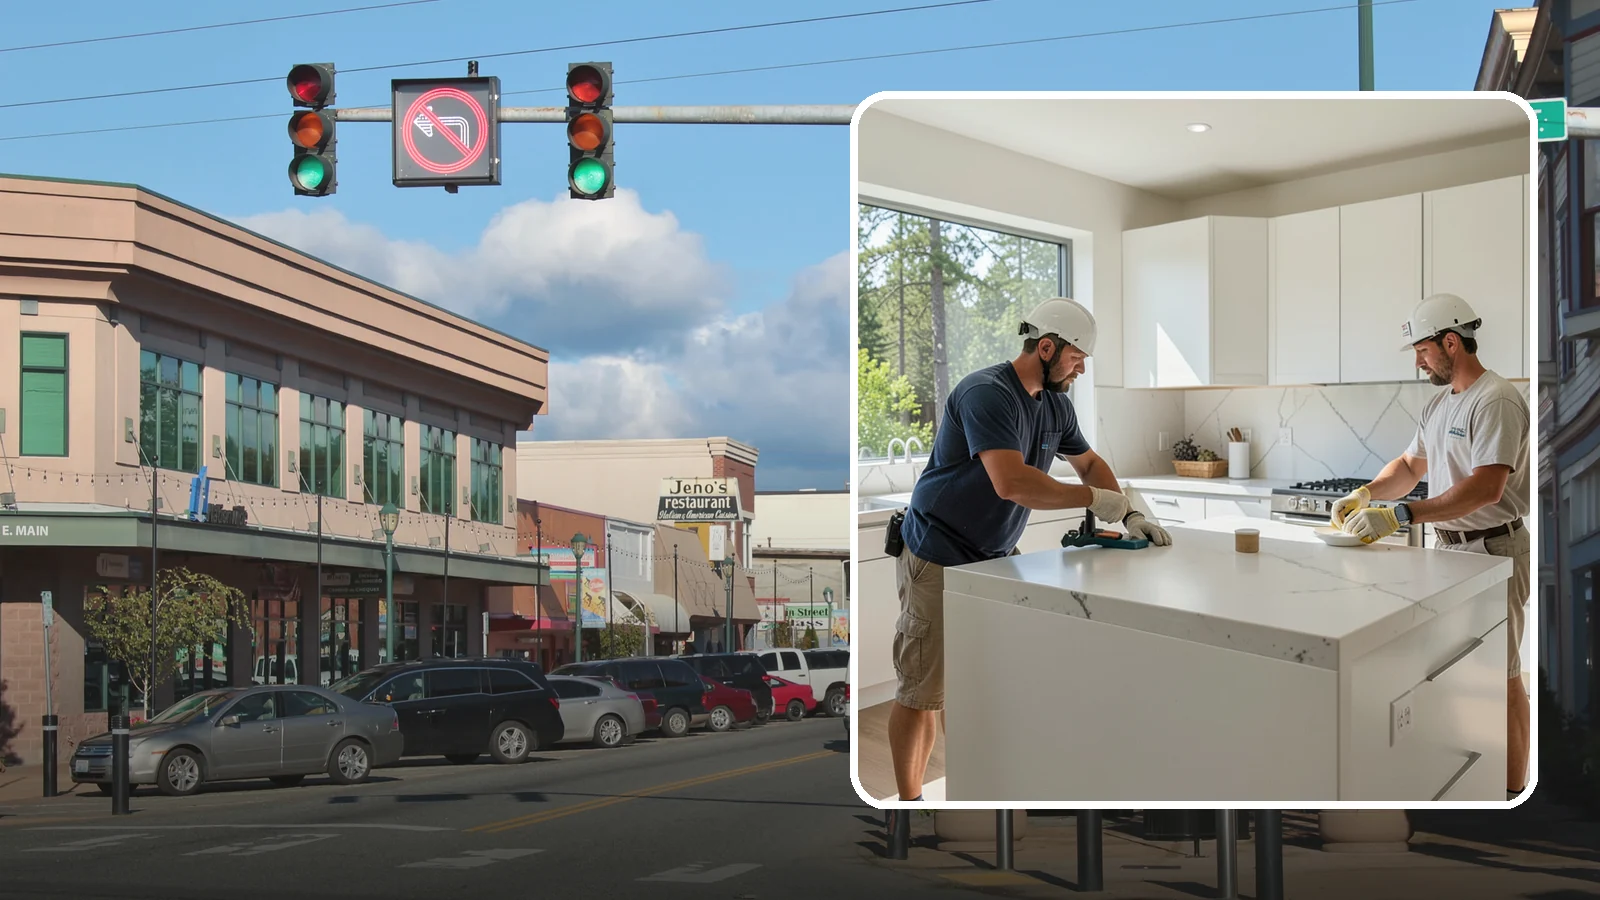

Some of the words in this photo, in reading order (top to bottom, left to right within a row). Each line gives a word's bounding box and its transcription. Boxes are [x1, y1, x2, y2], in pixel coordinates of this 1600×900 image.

[670, 480, 727, 494] Jeno's
[665, 497, 731, 509] restaurant
[659, 510, 681, 519] Italian
[686, 510, 714, 519] American
[715, 510, 737, 519] Cuisine
[2, 525, 13, 536] E.
[15, 525, 49, 536] MAIN
[797, 607, 828, 617] Street
